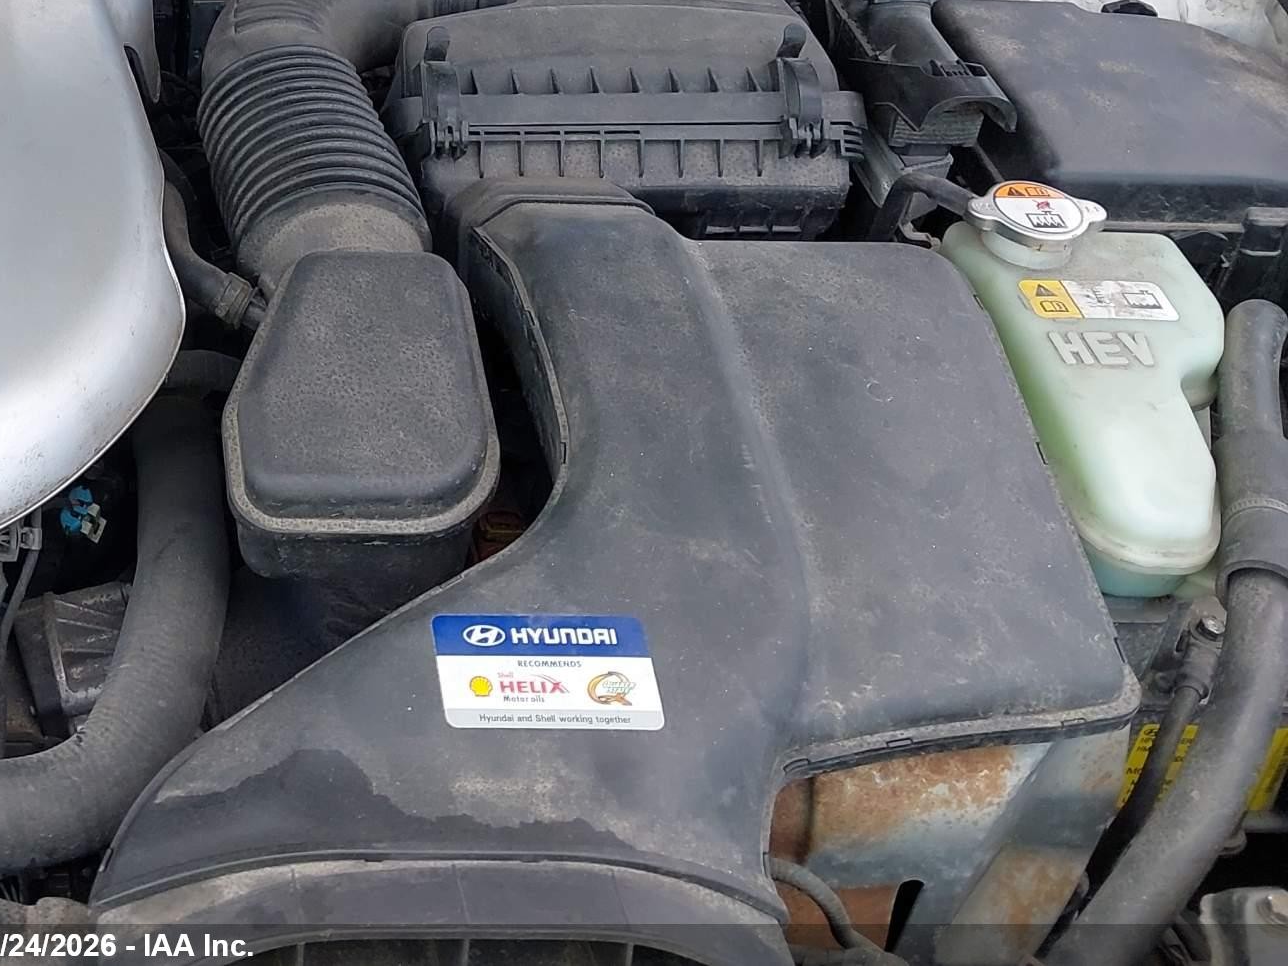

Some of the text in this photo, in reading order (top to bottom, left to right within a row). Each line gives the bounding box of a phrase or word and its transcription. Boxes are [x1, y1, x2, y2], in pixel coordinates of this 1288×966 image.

[1047, 330, 1155, 367] HEV
[511, 627, 618, 645] HYUNDAI
[517, 659, 582, 668] RECOMMENDS
[499, 681, 565, 694] HELIX
[503, 695, 545, 703] Motor oils
[479, 713, 631, 725] Hyundai and Shell working together
